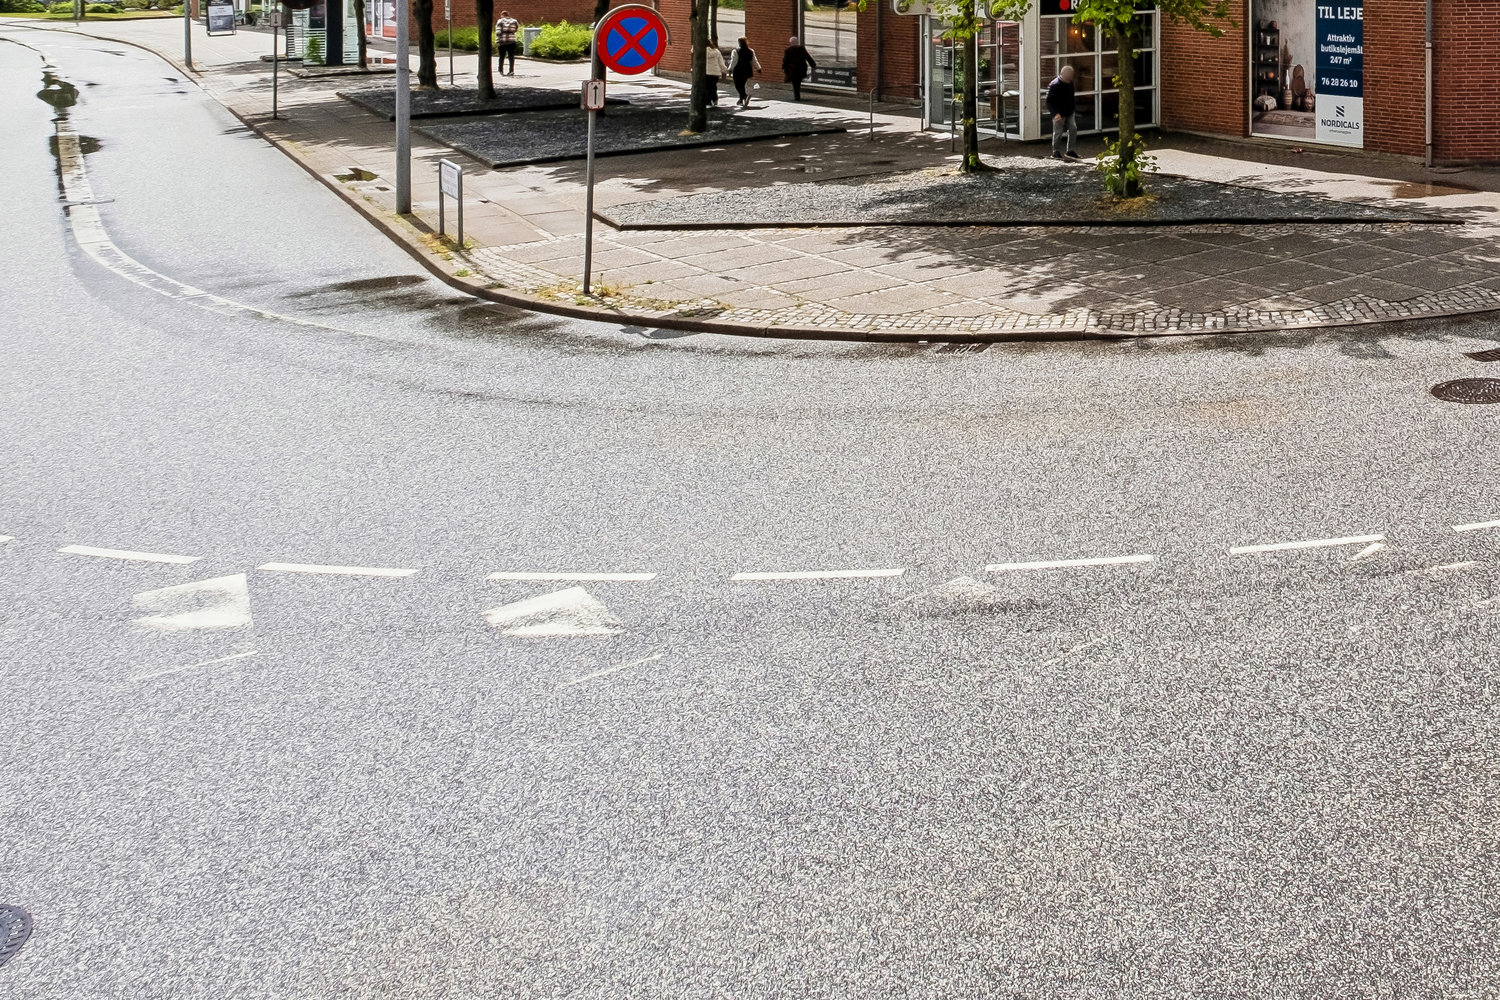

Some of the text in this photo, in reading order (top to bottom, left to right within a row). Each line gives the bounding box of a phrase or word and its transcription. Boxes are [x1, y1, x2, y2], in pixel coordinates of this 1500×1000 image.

[1317, 6, 1364, 20] TIL LEJE
[1327, 33, 1356, 43] Attraktiv
[1320, 43, 1363, 55] butikslejemål
[1330, 55, 1342, 64] 247
[1321, 77, 1358, 88] 76 28 26 10
[1320, 118, 1360, 130] NORDICALS
